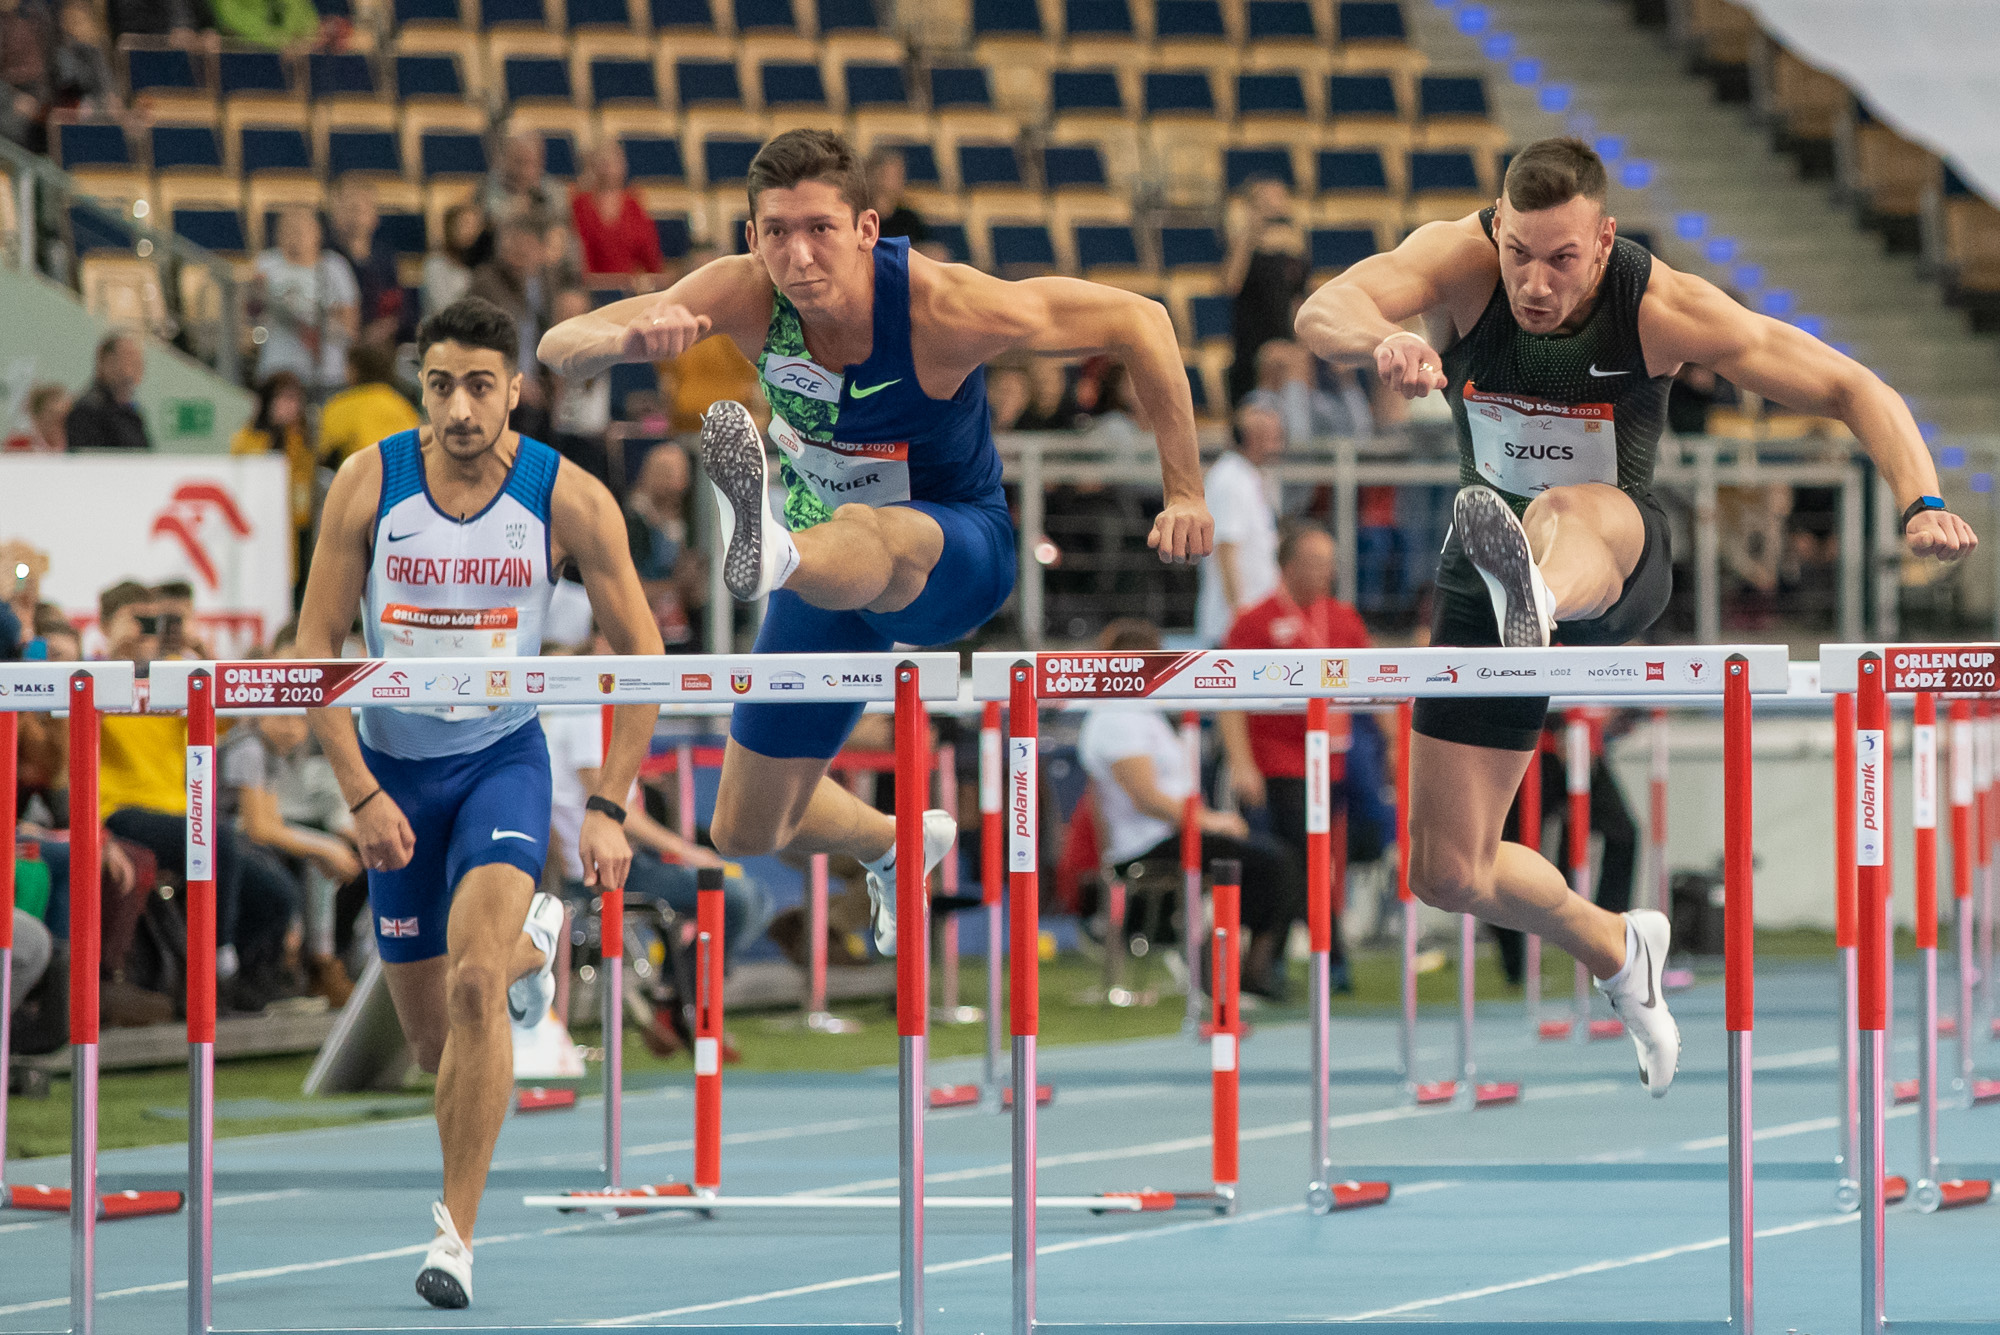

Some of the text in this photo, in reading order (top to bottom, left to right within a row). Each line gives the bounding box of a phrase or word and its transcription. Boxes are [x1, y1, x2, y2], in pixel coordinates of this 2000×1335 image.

[781, 373, 823, 393] PGE
[1513, 398, 1535, 411] CUP
[1571, 408, 1601, 416] 2020
[865, 442, 896, 454] 2020
[1504, 441, 1574, 461] SZUCS
[386, 554, 532, 588] GREAT BRITAIN
[392, 609, 428, 624] ORLEN
[429, 614, 451, 627] CUP
[483, 613, 508, 626] 2020
[1045, 657, 1145, 674] ORLEN CUP
[1894, 652, 1996, 669] ORLEN CUP
[224, 668, 324, 684] ORLEN CUP
[1493, 669, 1537, 677] LEXUS
[1588, 668, 1639, 677] NOVOTEL
[1894, 668, 1996, 688] ŁÓDŹ 2020
[1046, 673, 1146, 693] ŁÓDŹ 2020
[1196, 679, 1234, 687] ORLEN
[224, 683, 324, 703] ŁÓDŹ 2020
[374, 688, 409, 697] ORLEN
[1013, 769, 1031, 838] polanik
[1860, 762, 1879, 831] polanik
[189, 778, 207, 847] polanik
